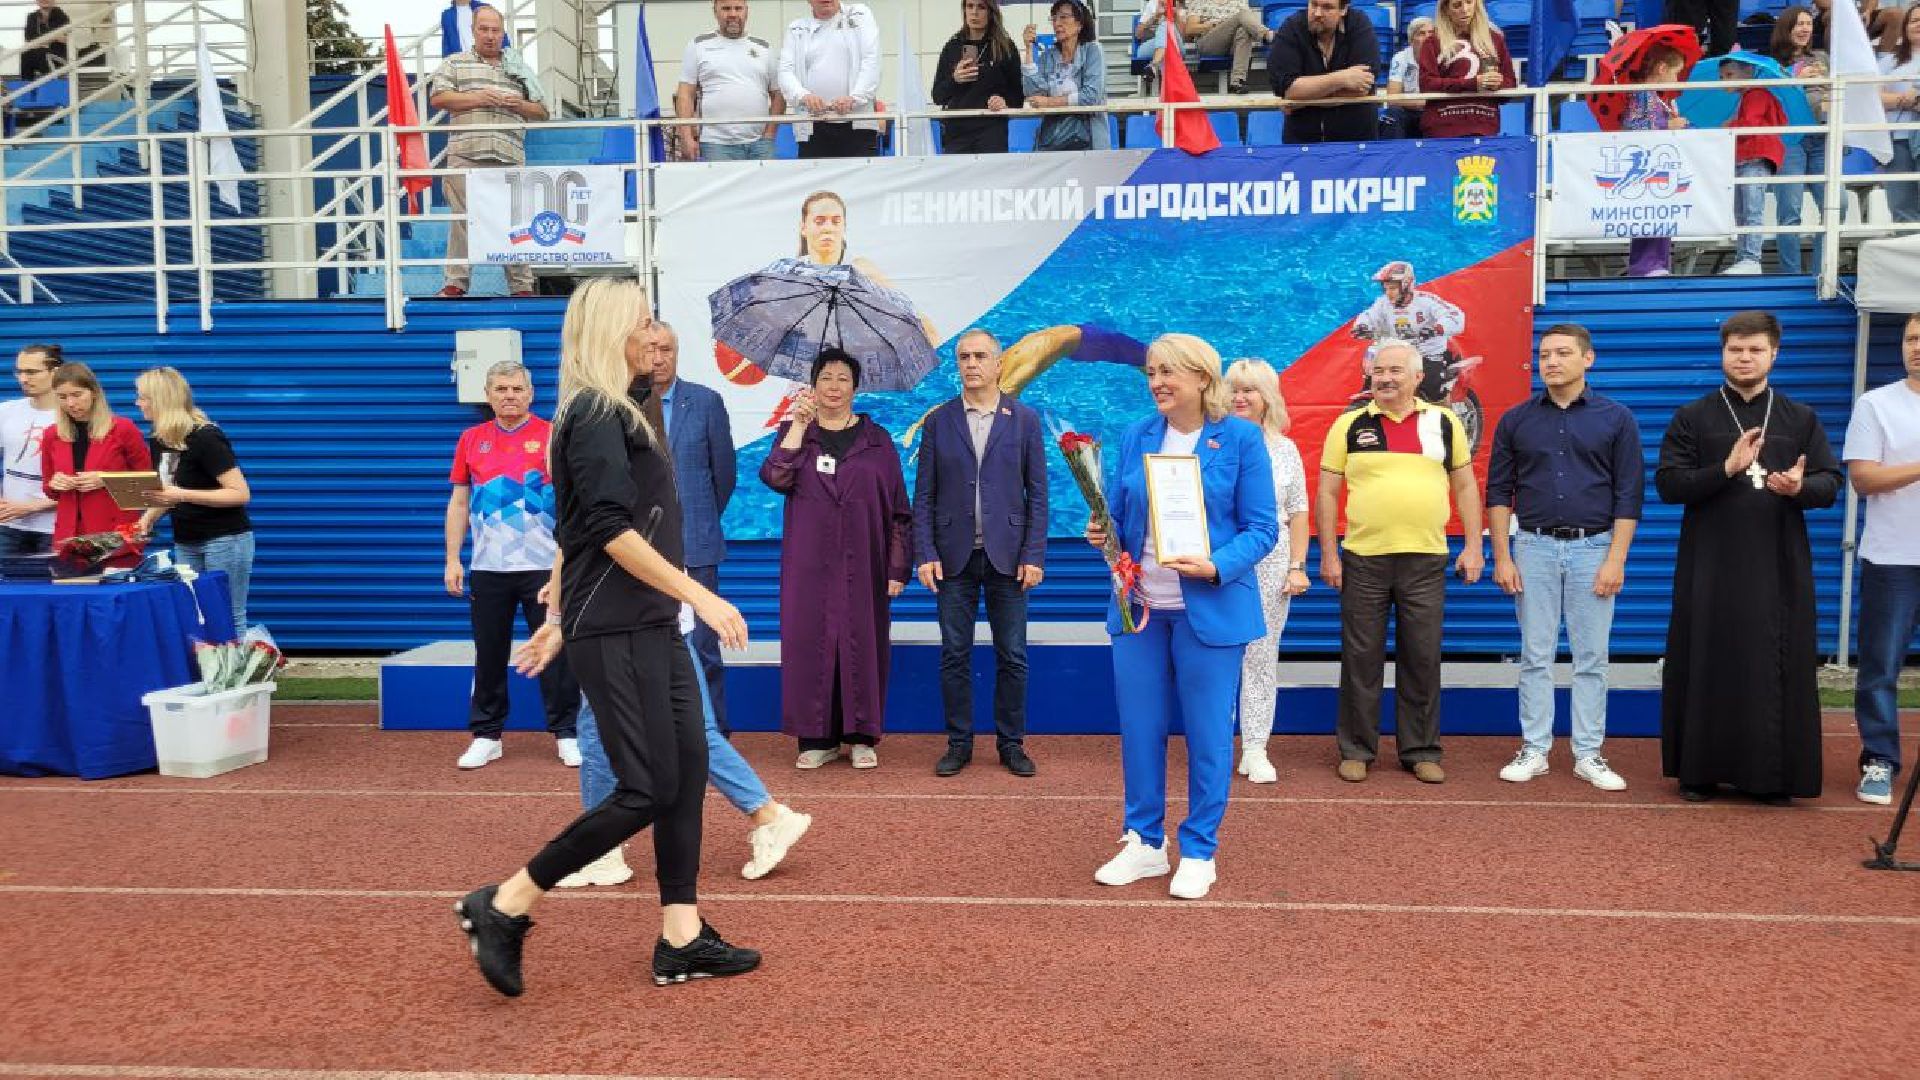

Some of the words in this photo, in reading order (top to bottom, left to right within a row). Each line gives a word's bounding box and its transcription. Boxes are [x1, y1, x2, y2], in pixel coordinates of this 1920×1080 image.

[1663, 161, 1682, 170] ЛЕТ
[570, 189, 593, 200] ЛЕТ
[880, 178, 1084, 226] ЛЕНИНСКИЙ
[1095, 171, 1300, 221] ГОРОДСКОЙ
[1311, 176, 1427, 214] ОКРУГ
[1590, 204, 1693, 221] МИНСПОРТ
[1604, 221, 1678, 237] РОССИИ
[486, 251, 569, 263] МИНИСТЕРСТВО
[572, 251, 613, 262] СПОРТА
